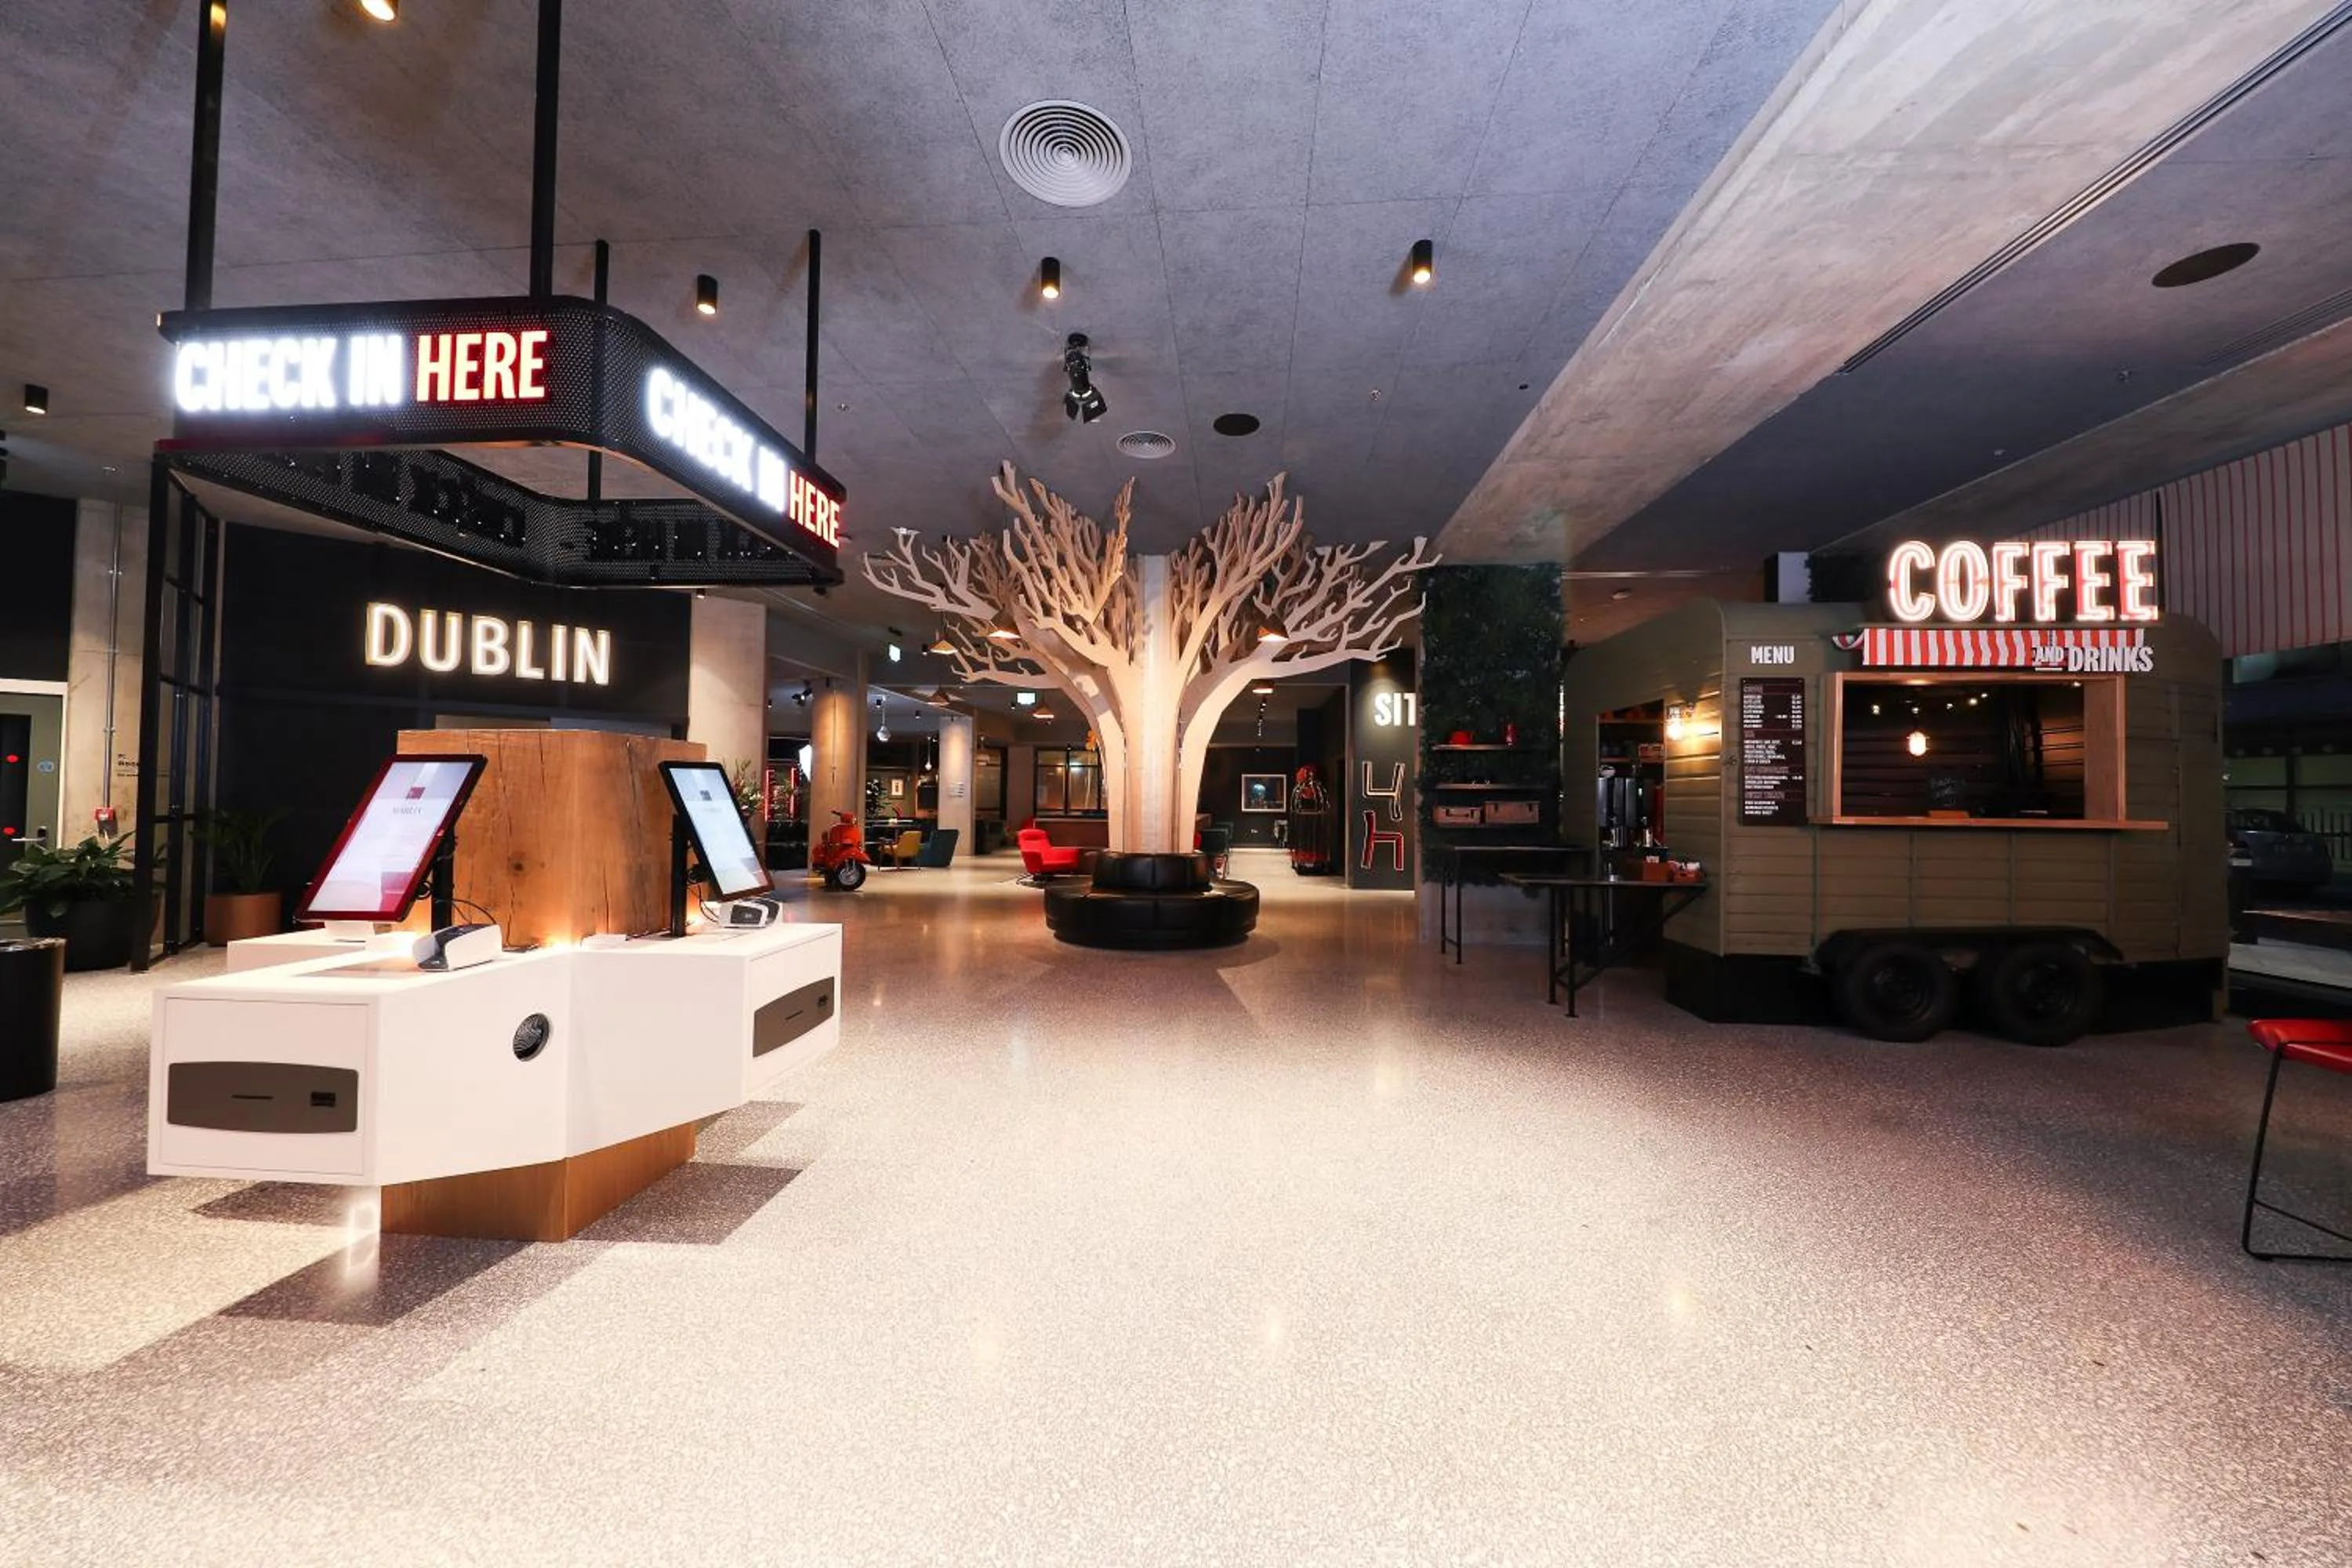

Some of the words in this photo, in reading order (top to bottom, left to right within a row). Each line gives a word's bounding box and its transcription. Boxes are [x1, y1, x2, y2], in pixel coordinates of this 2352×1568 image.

[175, 337, 337, 412] CHECK
[349, 333, 403, 407] IN
[416, 330, 548, 402] HERE
[647, 366, 754, 493] CHECK
[757, 445, 786, 513] IN
[789, 470, 840, 549] HERE
[1888, 539, 2159, 622] COFFEE
[365, 601, 611, 686] DUBLIN
[1751, 645, 1795, 664] MENU
[2034, 646, 2064, 665] AND
[2067, 646, 2154, 673] DRINKS
[1374, 692, 1417, 727] SIT
